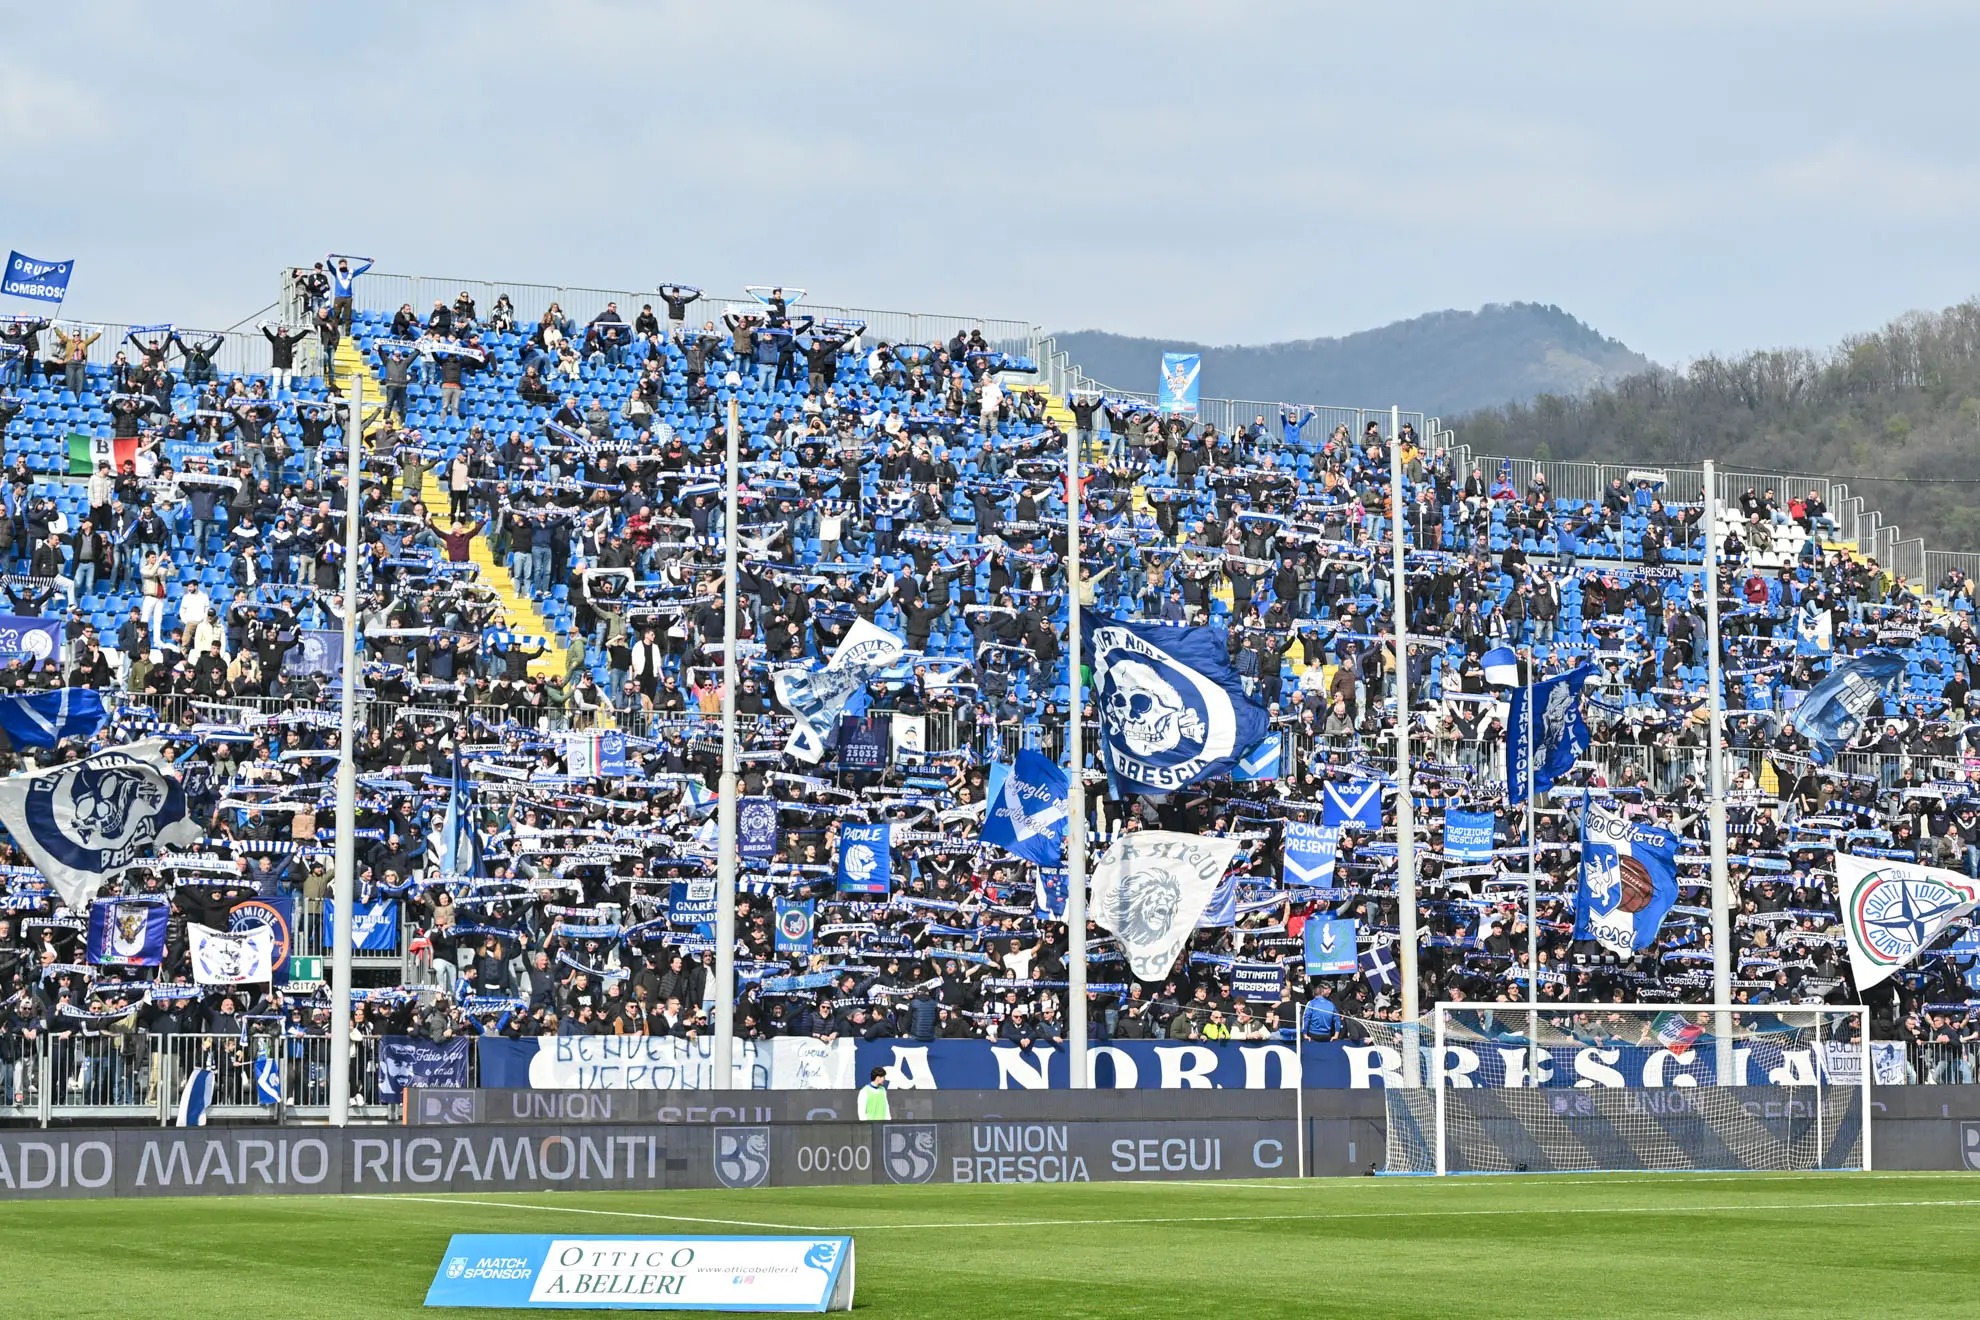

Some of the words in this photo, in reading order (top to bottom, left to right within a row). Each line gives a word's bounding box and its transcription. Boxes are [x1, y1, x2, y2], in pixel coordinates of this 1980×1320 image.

[1638, 566, 1678, 578] BRESCIA
[632, 607, 656, 615] CURVA
[1117, 754, 1208, 786] BRESCIA
[1340, 820, 1366, 829] 25050
[1447, 826, 1491, 836] TRADIZIONE
[843, 826, 883, 841] PADILE
[1447, 836, 1490, 845] BRESCIANA
[1287, 838, 1335, 855] PRESENTI
[13, 866, 35, 875] NORD
[1892, 870, 1911, 879] 2011
[456, 896, 482, 904] CURVA
[1865, 884, 1900, 918] SOLITI
[229, 906, 278, 927] SIRMIONE
[881, 935, 898, 943] BELLO
[1869, 930, 1912, 955] CURVA
[512, 1094, 611, 1118] UNION
[973, 1125, 1068, 1153] UNION
[135, 1138, 329, 1186] MARIO
[353, 1135, 656, 1183] RIGAMONTI
[797, 1145, 870, 1172] 00:00
[1111, 1138, 1221, 1172] SEGUI
[952, 1156, 1090, 1183] BRESCIA
[476, 1258, 527, 1268] MATCH
[560, 1247, 695, 1267] OTTICO
[463, 1268, 532, 1280] SPONSOR
[697, 1266, 799, 1274] www.otticobelleri.it
[545, 1275, 685, 1295] A.BELLERI
